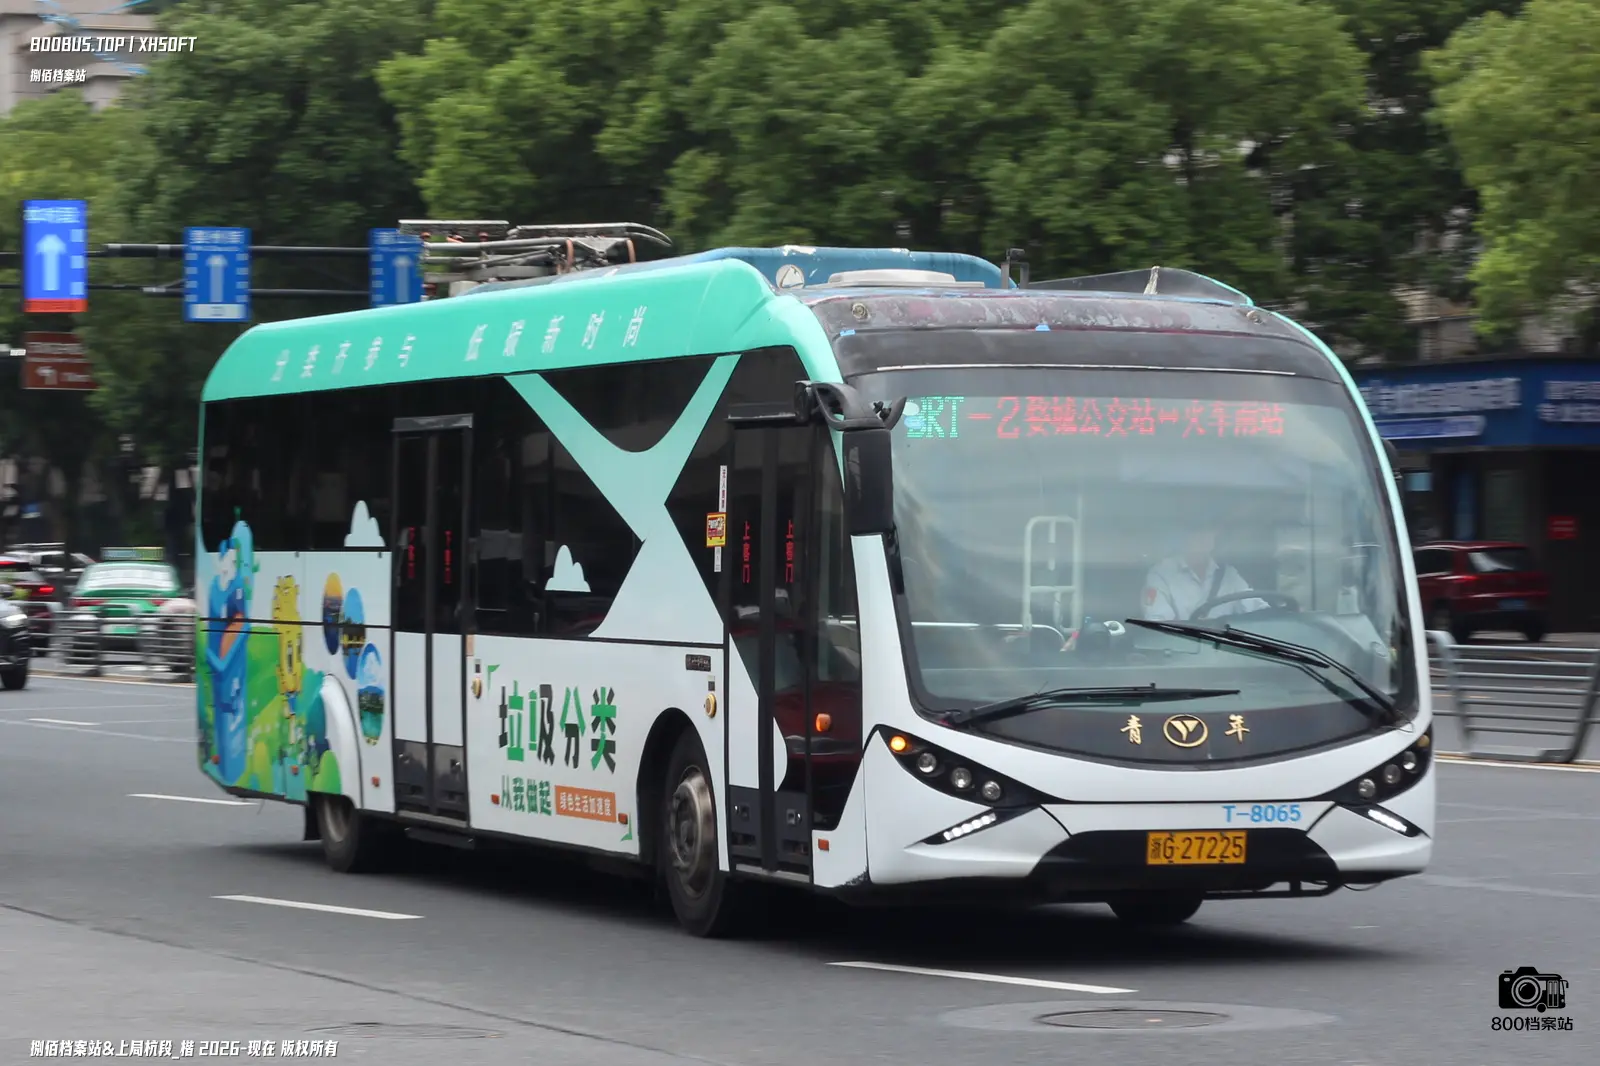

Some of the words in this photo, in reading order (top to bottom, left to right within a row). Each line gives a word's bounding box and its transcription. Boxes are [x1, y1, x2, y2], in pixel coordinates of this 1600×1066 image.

[499, 680, 617, 774] 垃圾分类
[501, 775, 552, 816] 从我做起
[1222, 804, 1301, 823] T-8065
